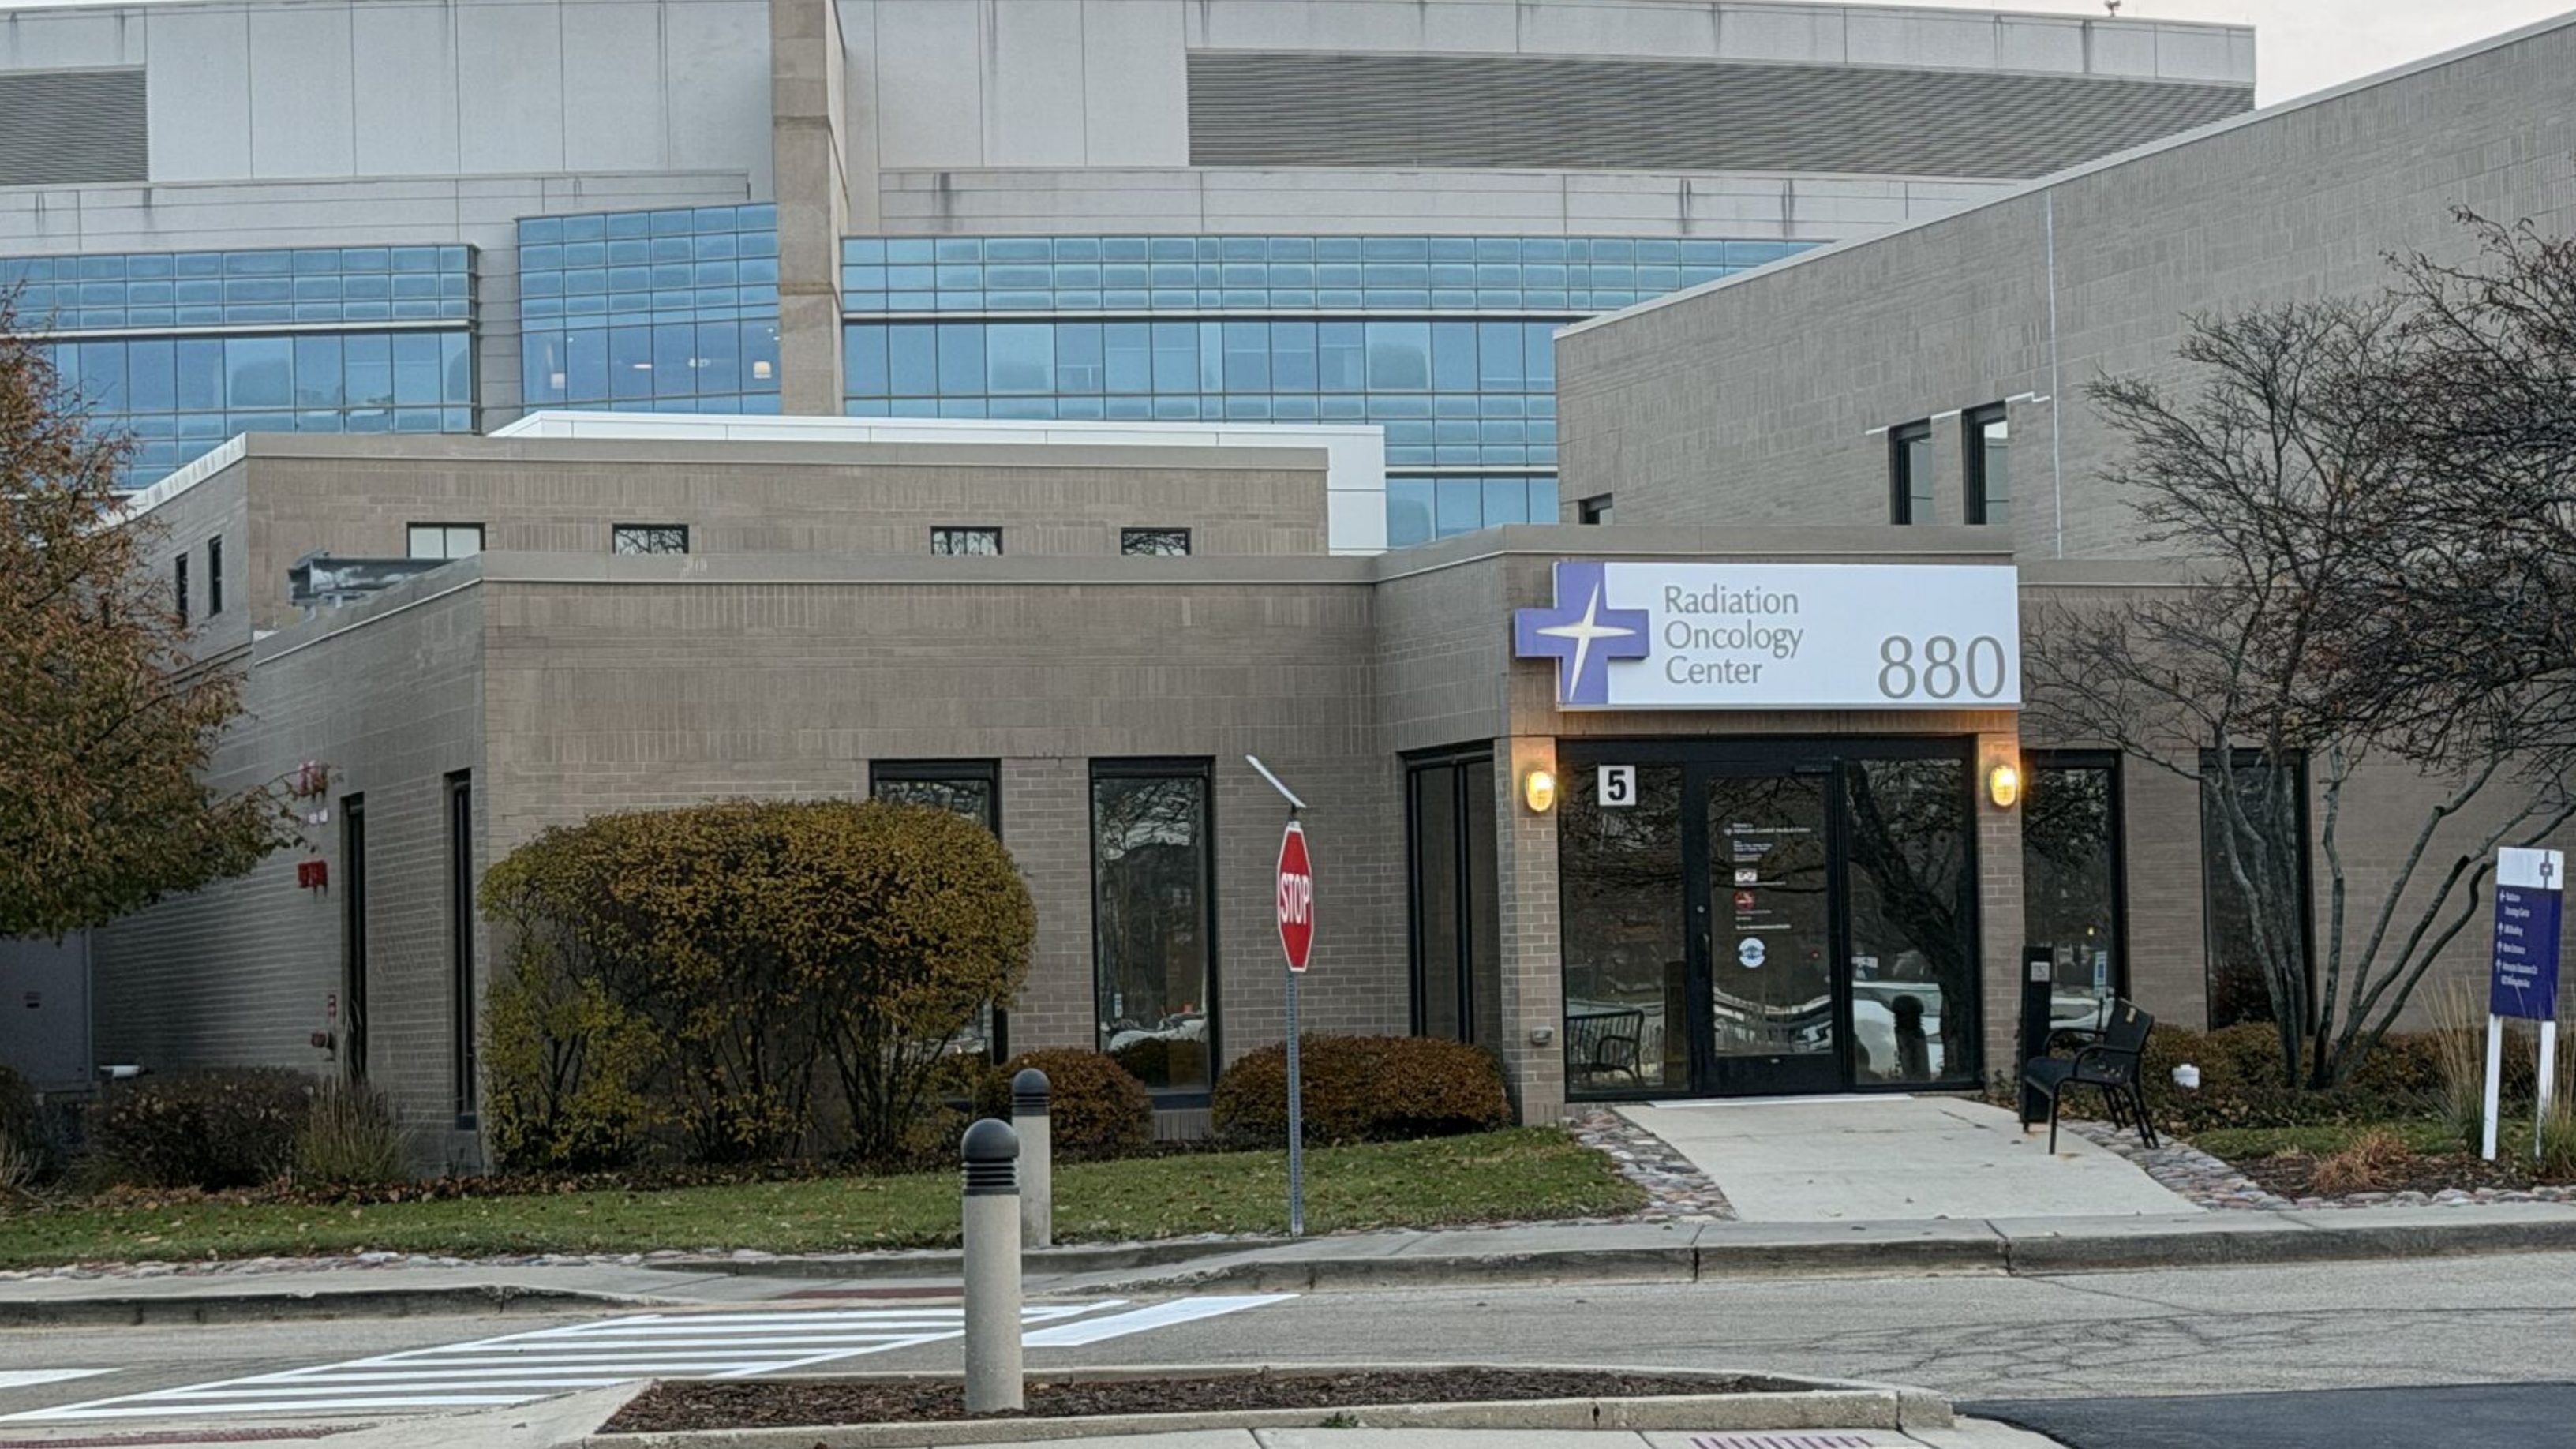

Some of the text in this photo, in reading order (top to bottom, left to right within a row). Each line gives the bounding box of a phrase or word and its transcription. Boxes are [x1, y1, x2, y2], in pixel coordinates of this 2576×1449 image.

[1664, 582, 1799, 615] Radiation
[1664, 618, 1804, 659] Oncology
[1665, 655, 1762, 684] Center
[1878, 635, 2006, 699] 880
[1608, 769, 1627, 801] 5
[1279, 871, 1310, 925] STOP
